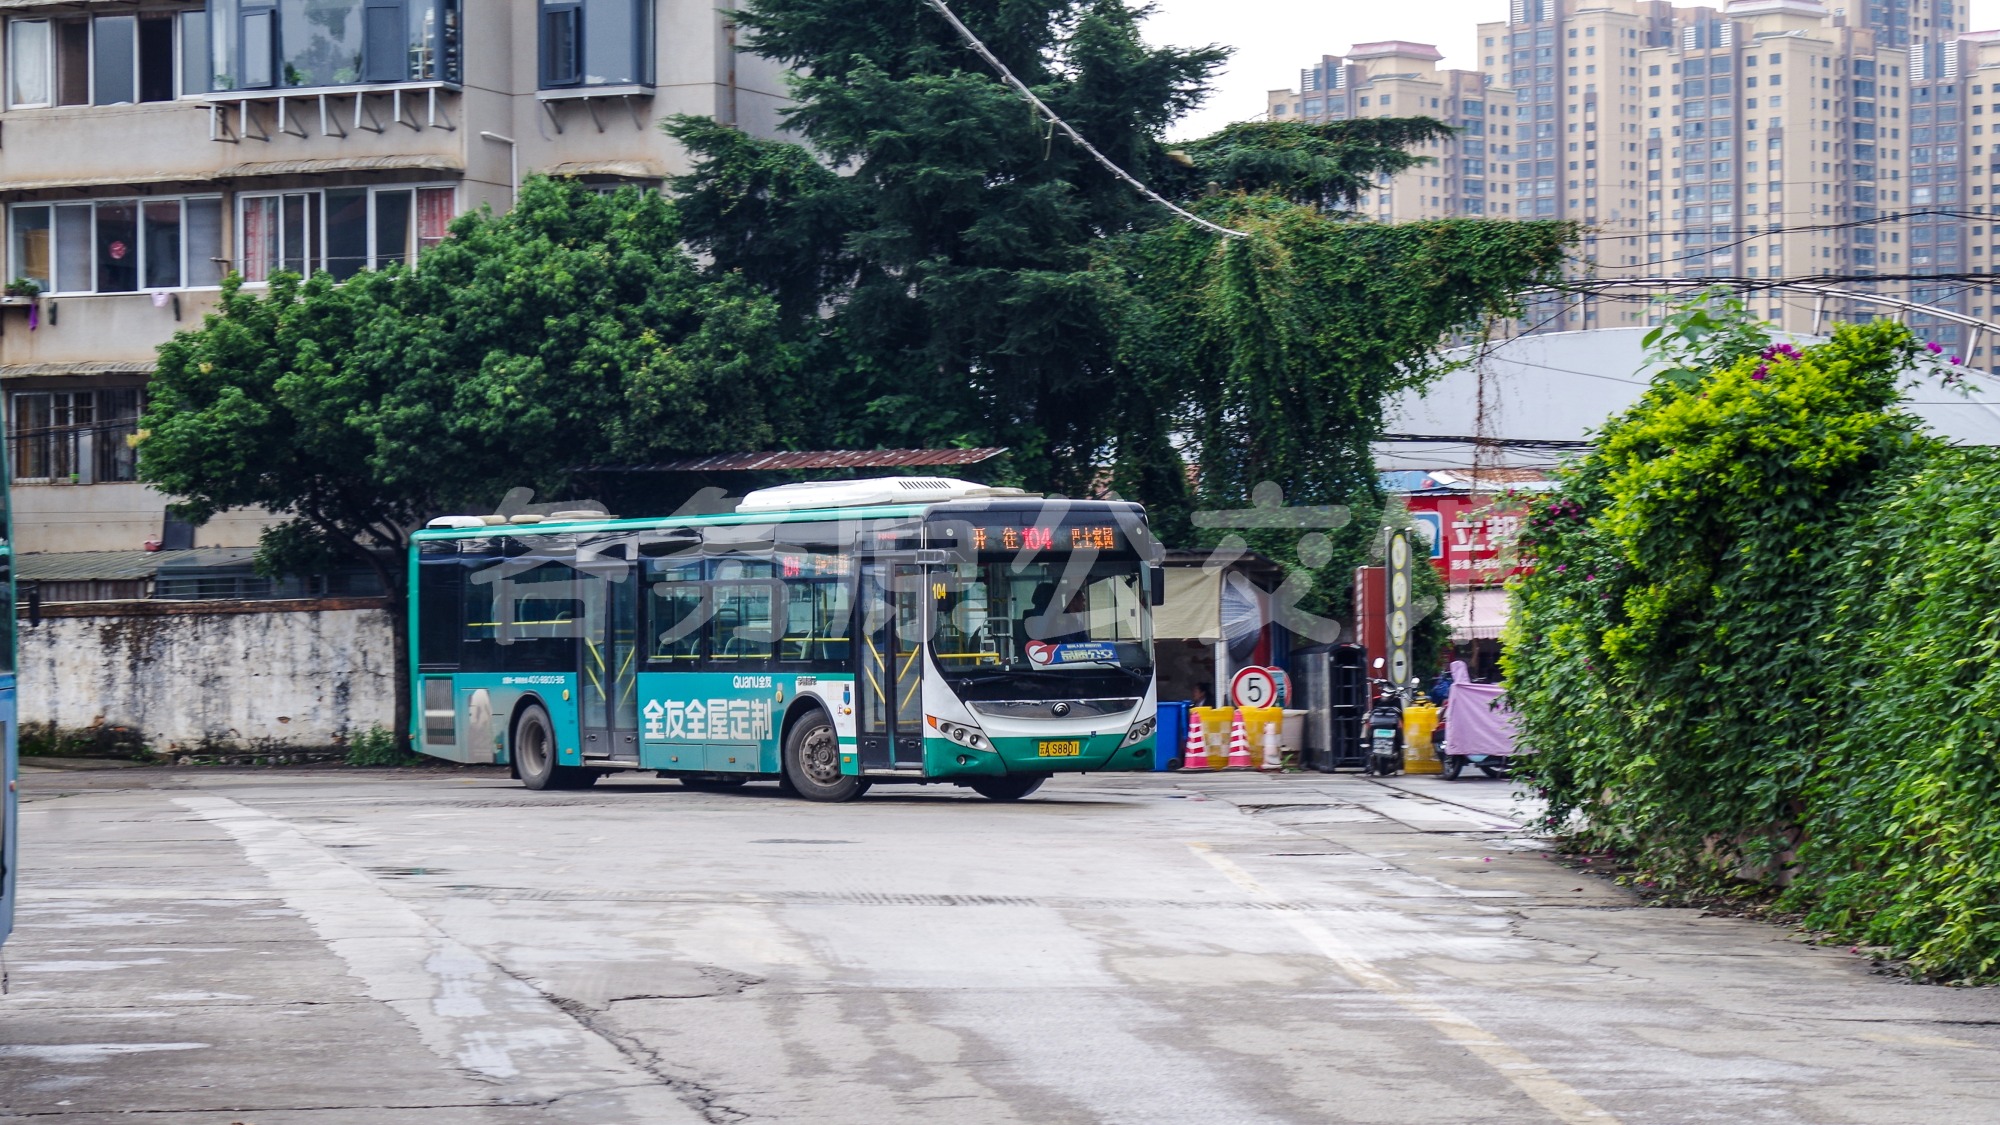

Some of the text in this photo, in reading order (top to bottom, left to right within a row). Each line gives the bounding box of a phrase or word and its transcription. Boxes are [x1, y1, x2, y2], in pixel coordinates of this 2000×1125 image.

[1021, 527, 1053, 550] 104
[782, 555, 800, 578] 104
[932, 583, 947, 600] 104
[1247, 677, 1263, 703] 5
[643, 698, 773, 740] 全友全屋定制
